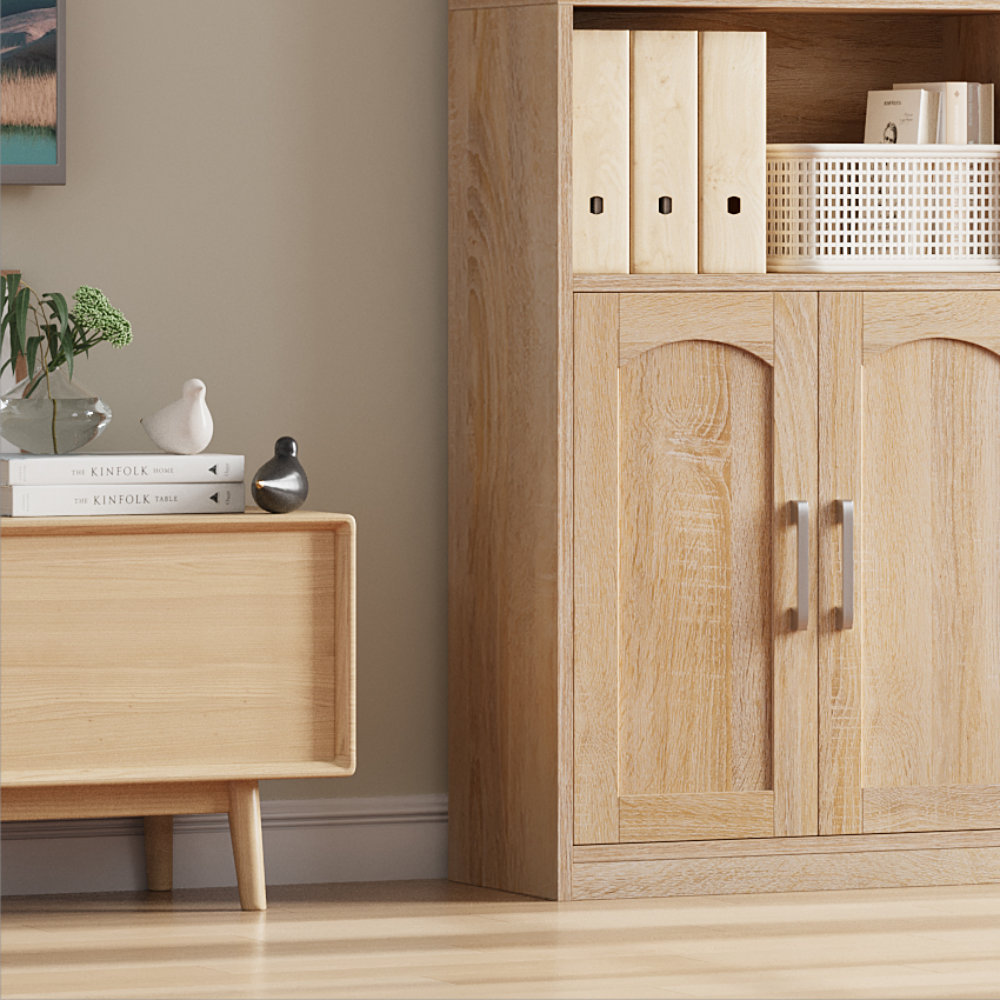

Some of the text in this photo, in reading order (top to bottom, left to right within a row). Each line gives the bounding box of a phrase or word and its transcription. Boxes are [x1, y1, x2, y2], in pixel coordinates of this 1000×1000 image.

[90, 465, 149, 477] KINFOLK
[153, 467, 174, 475] HOME
[93, 494, 151, 505] KINFOLK
[155, 495, 178, 503] TABLE
